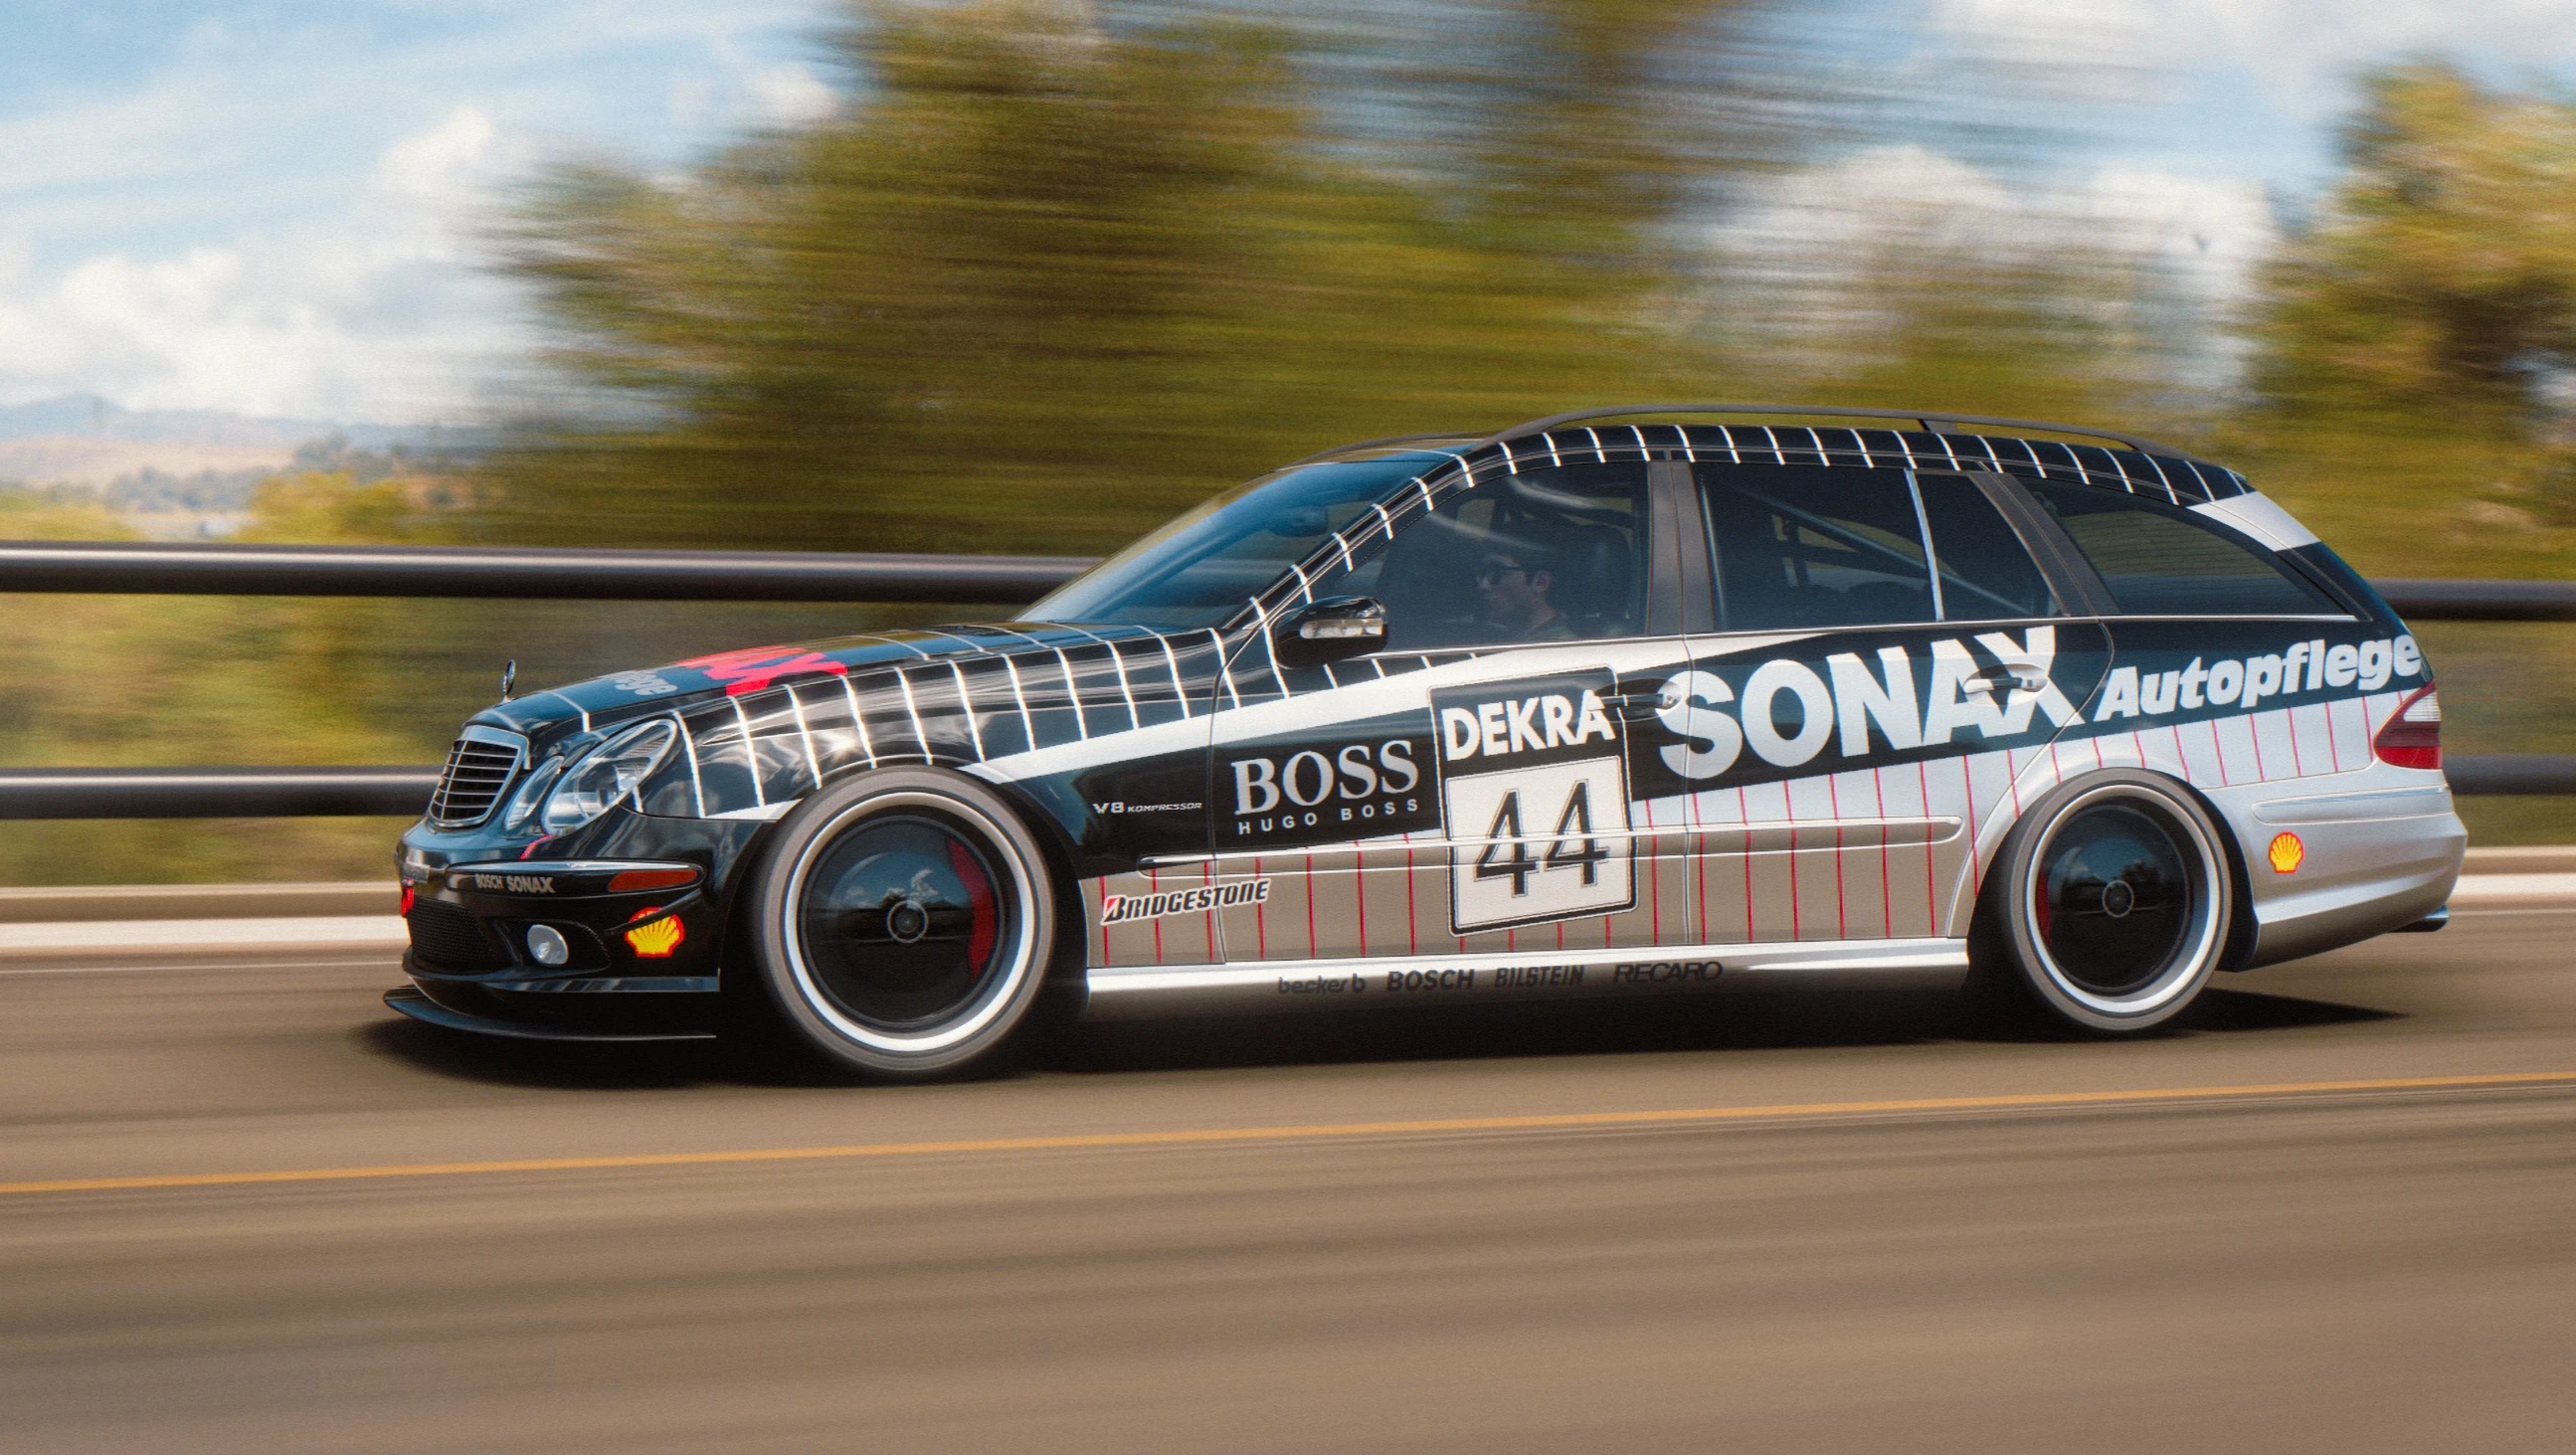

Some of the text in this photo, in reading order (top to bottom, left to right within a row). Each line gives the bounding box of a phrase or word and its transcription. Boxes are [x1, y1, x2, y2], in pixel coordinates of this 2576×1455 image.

[1656, 626, 2422, 780] SONAX Autopflege
[1442, 689, 1616, 761] DEKRA
[1230, 740, 1418, 816] BOSS
[1092, 801, 1202, 814] V8 KOMPRESSOR
[1238, 799, 1418, 834] HUGO BOSS
[1474, 779, 1610, 898] 44
[475, 873, 556, 893] BOSCH SONAX
[1101, 879, 1270, 925] BRIDGESTONE
[1387, 968, 1475, 992] BOSCH
[1494, 964, 1584, 988] BILSTEIN
[1613, 961, 1723, 984] RECARO
